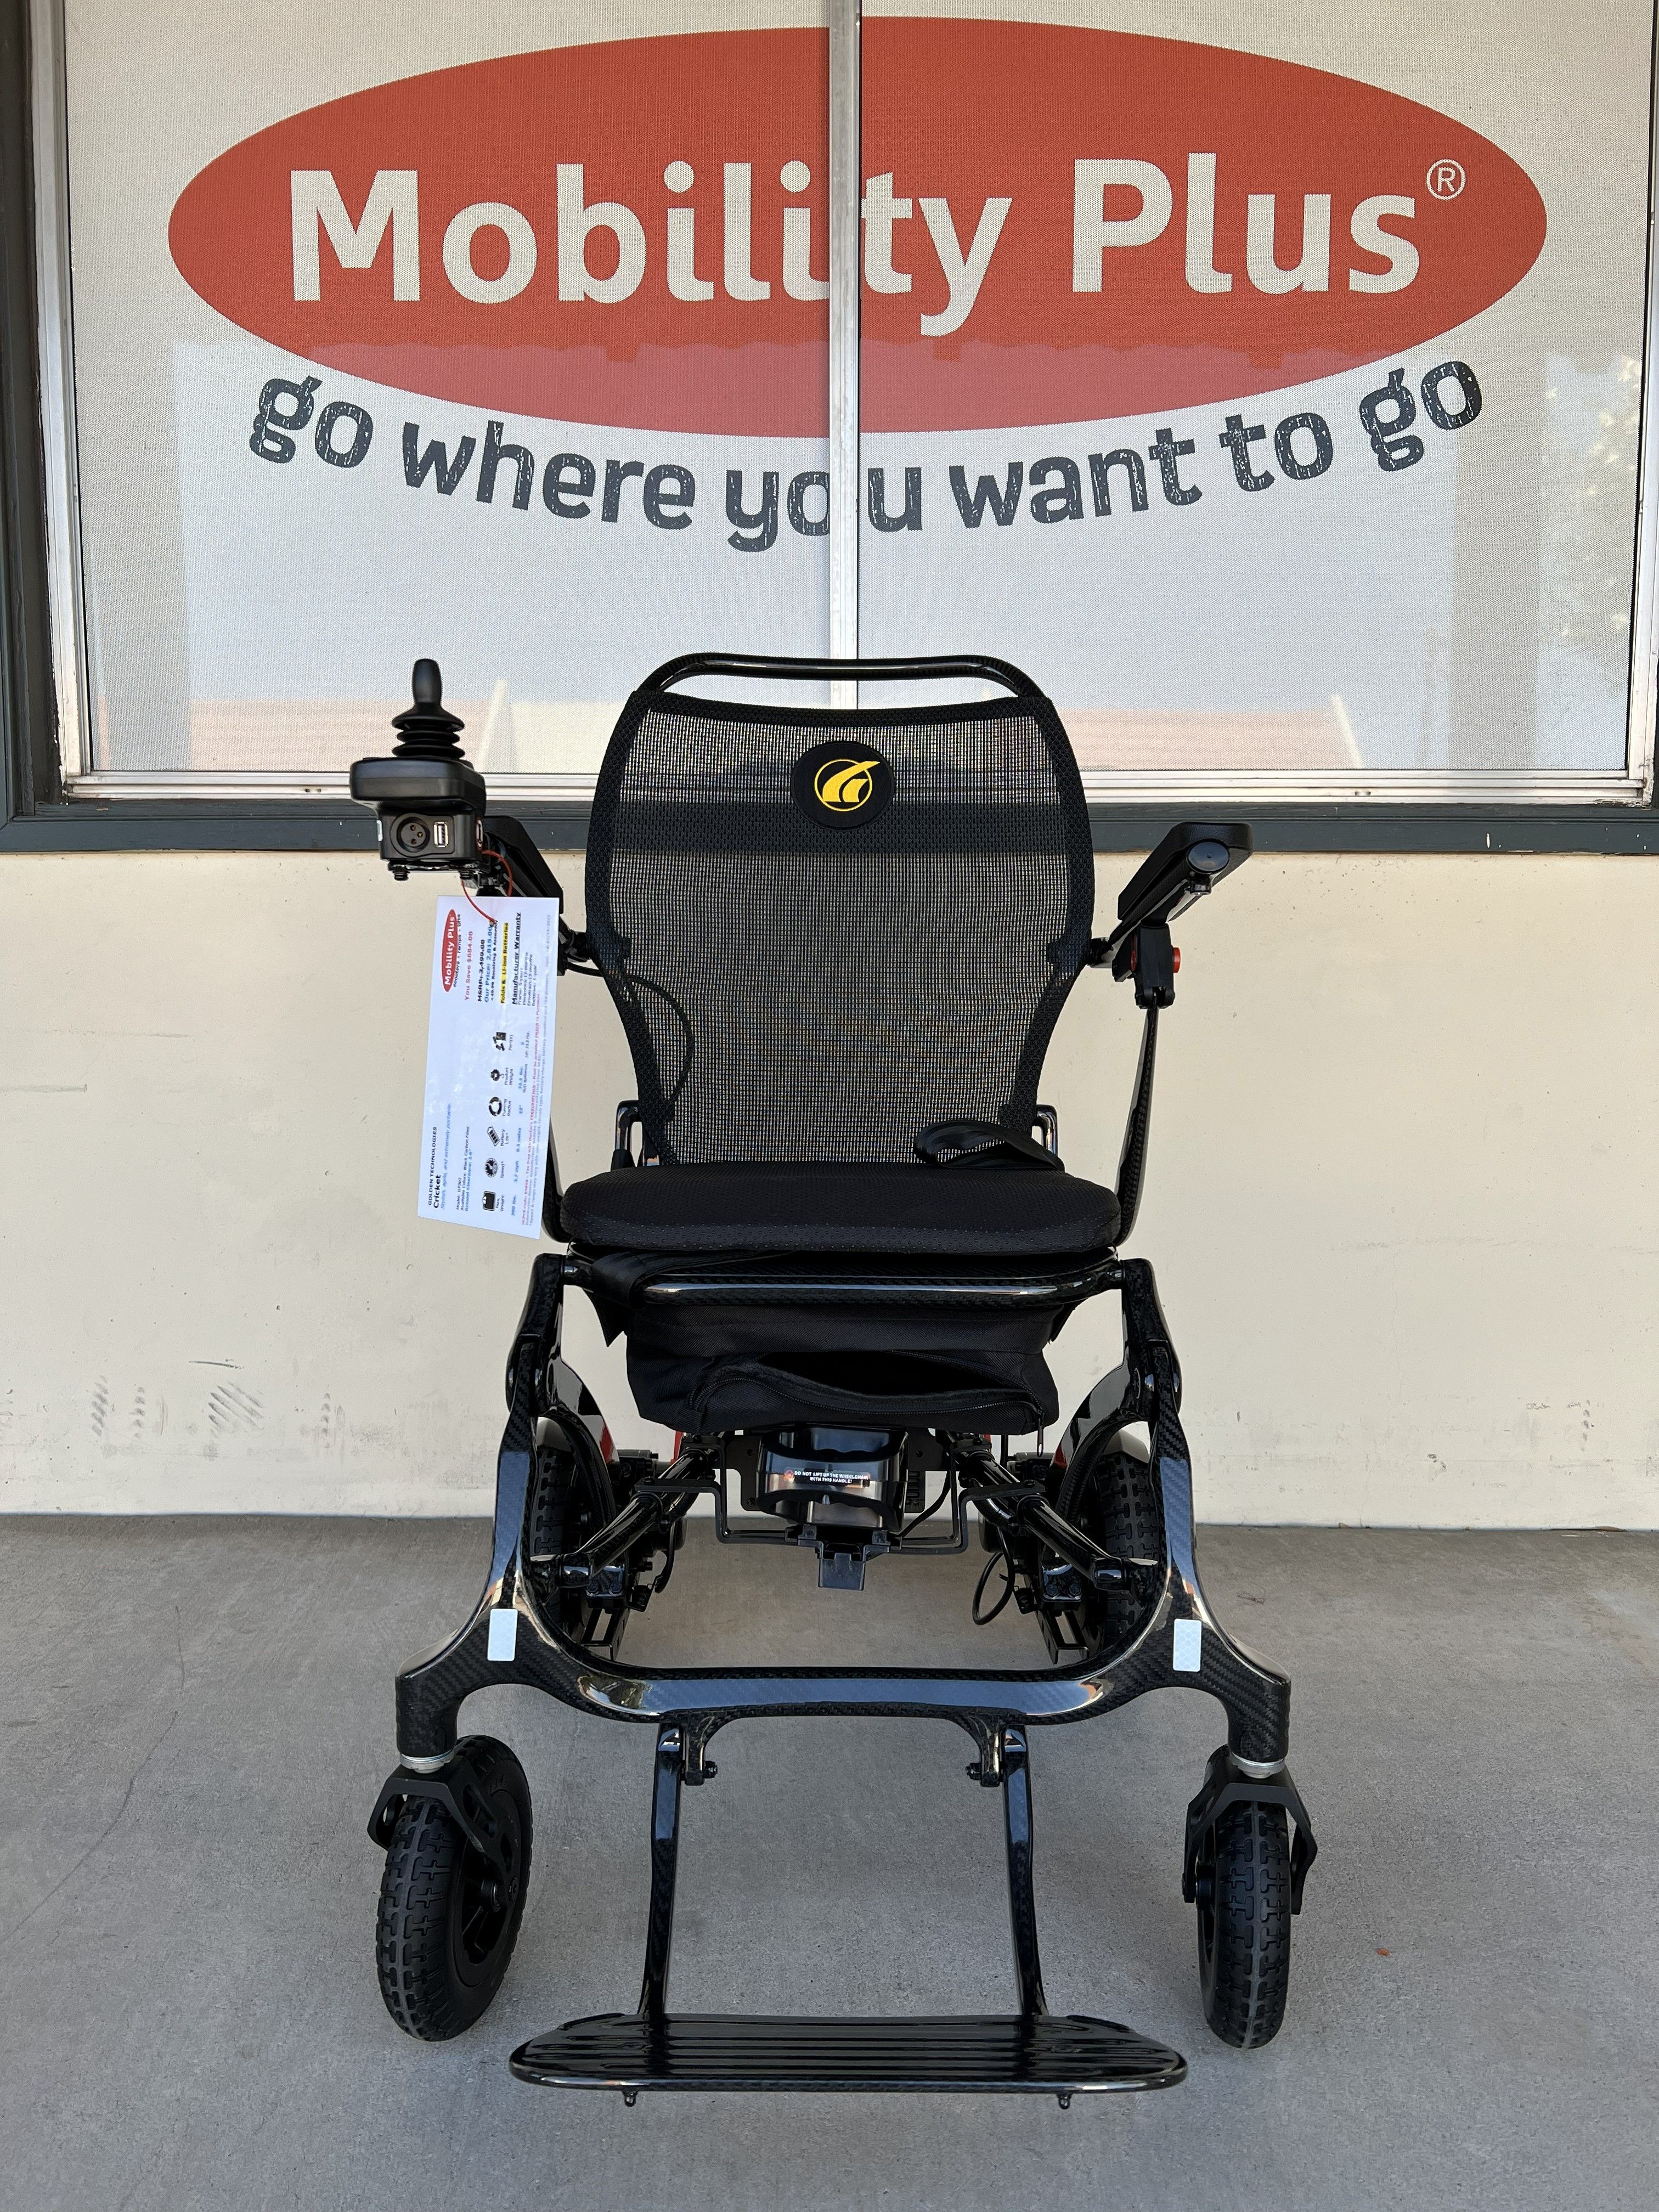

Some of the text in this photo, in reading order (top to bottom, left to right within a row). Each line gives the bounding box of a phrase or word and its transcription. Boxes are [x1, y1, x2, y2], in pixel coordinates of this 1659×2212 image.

[290, 160, 1012, 337] Mobility
[249, 360, 1482, 552] go where you want to go
[444, 941, 455, 985] Mobility
[511, 951, 520, 1005] Manufacturer
